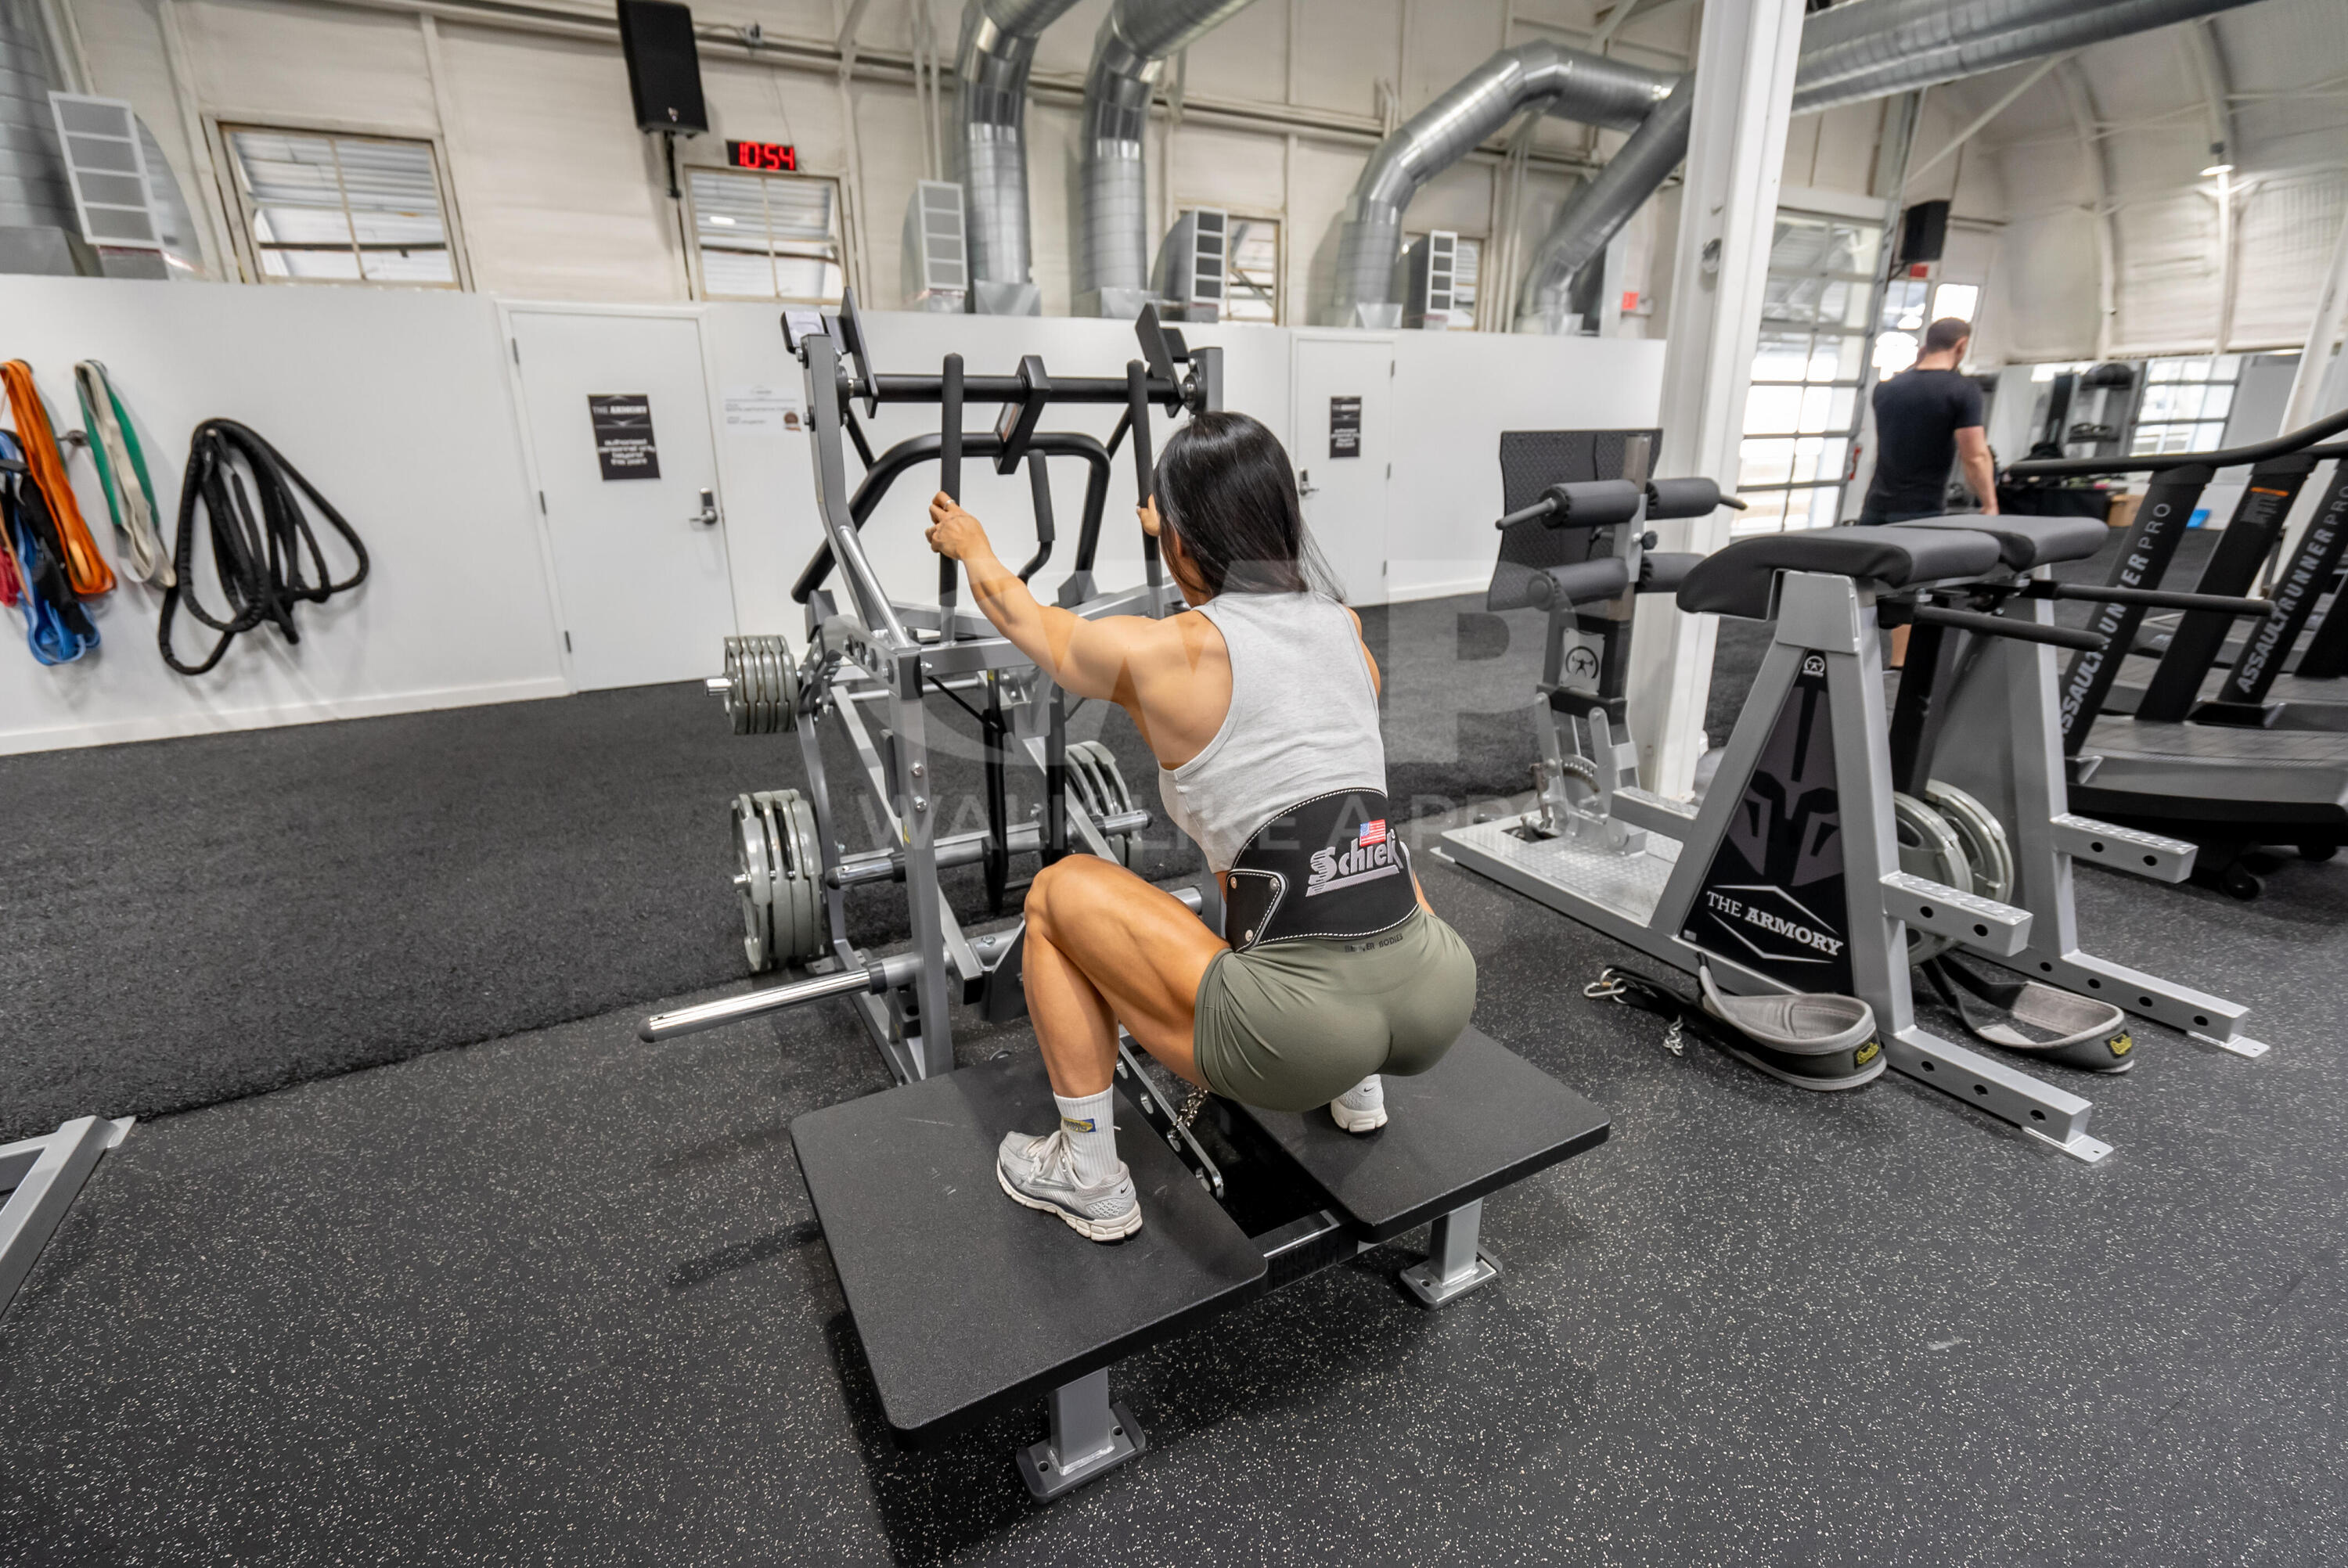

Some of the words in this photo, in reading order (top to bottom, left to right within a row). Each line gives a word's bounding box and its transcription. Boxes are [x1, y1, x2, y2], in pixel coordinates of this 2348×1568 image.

[2137, 503, 2171, 549] PRO
[1308, 829, 1404, 885] Schiek
[1706, 890, 1743, 918] THE
[1745, 906, 1844, 956] ARMORY
